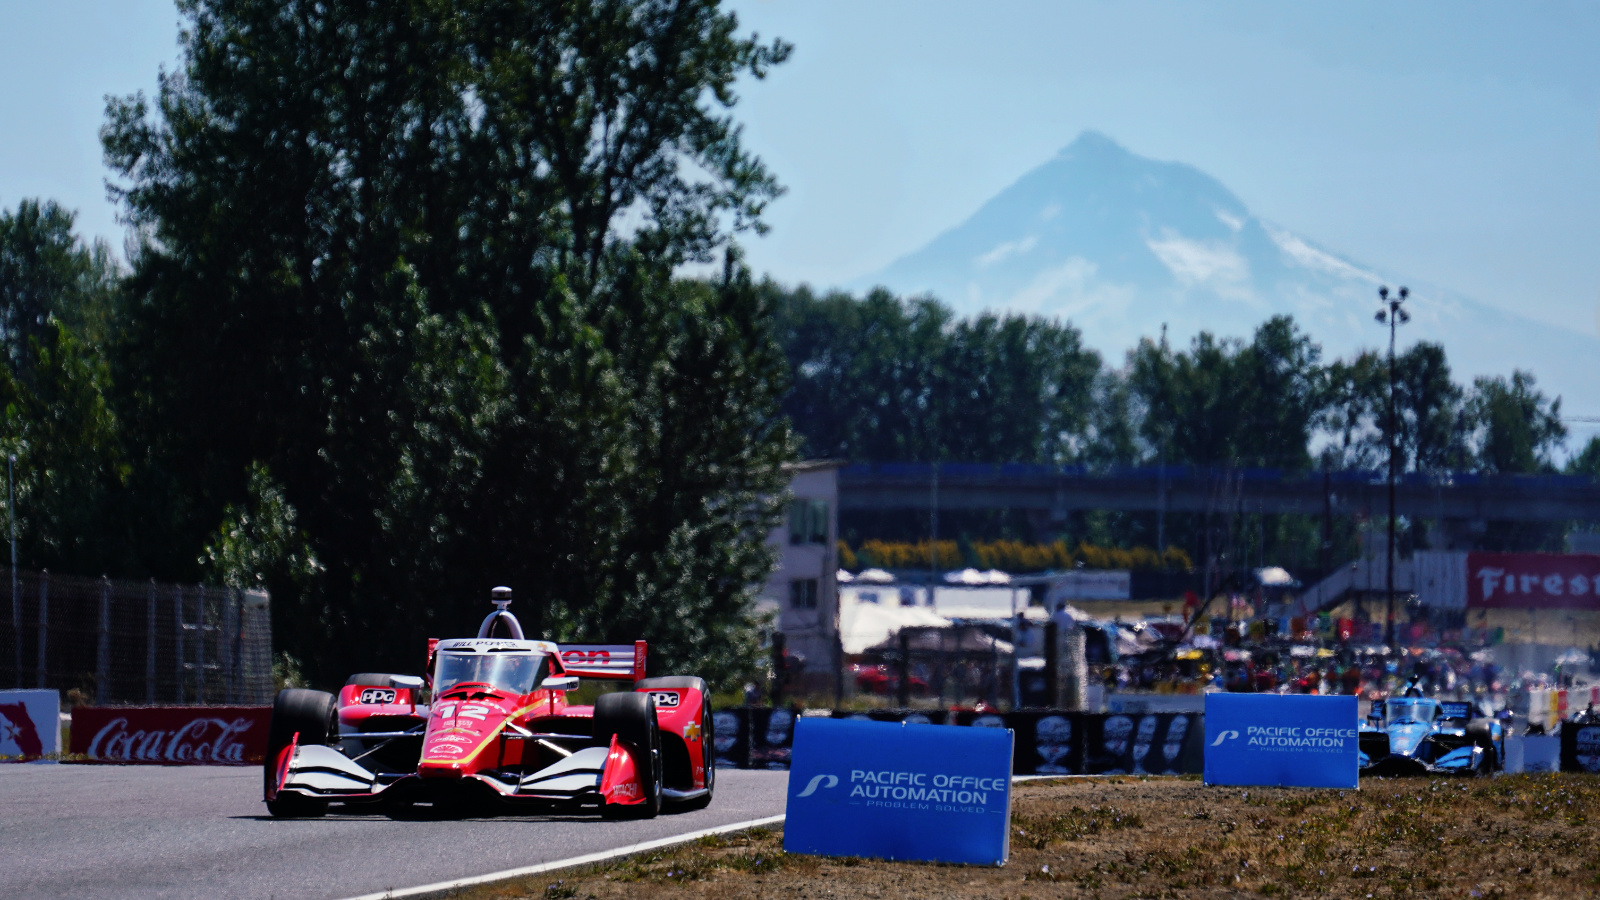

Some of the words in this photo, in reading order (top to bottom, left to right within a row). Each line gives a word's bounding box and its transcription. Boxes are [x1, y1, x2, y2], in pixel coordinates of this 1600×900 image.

[362, 690, 394, 704] PPG
[440, 705, 490, 721] 12
[88, 717, 253, 761] Coca-Cola
[1247, 726, 1301, 737] PACIFIC
[1305, 727, 1356, 738] OFFICE
[1247, 737, 1344, 747] AUTOMATION
[850, 770, 926, 786] PACIFIC
[932, 774, 1005, 791] OFFICE
[850, 785, 987, 804] AUTOMATION
[866, 800, 929, 810] PROBLEM
[935, 804, 985, 814] SOLVED
